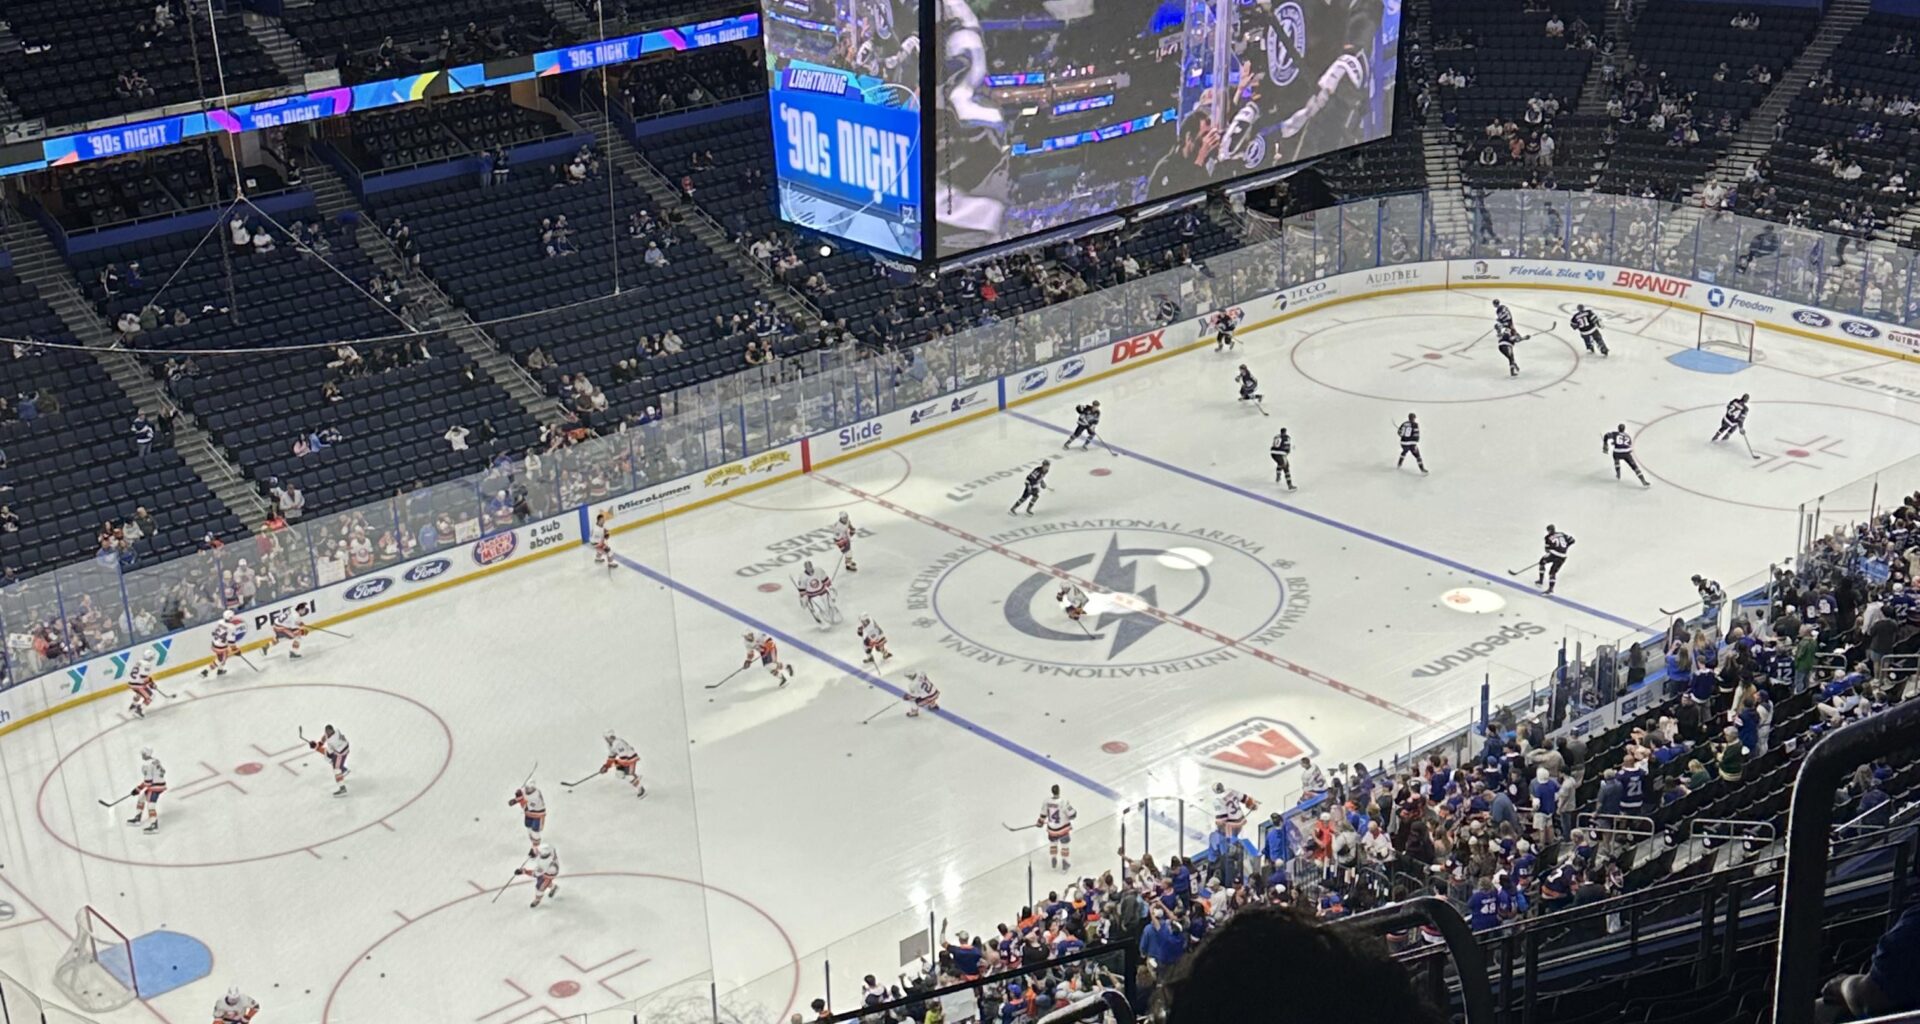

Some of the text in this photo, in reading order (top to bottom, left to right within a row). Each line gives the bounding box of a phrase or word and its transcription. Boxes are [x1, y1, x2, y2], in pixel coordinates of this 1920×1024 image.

[597, 41, 628, 63] NIGHT
[787, 69, 847, 96] LIGHTNING
[87, 125, 166, 155] '90s NIGHT
[780, 102, 910, 199] '90s NIGHT
[1366, 269, 1420, 285] AUDIBEL
[1509, 265, 1553, 277] Florida
[1556, 268, 1582, 279] Blue
[1290, 282, 1327, 299] TECO
[1612, 271, 1692, 299] BRANDT
[1728, 294, 1774, 313] freedom
[1798, 311, 1826, 327] Ford
[1846, 322, 1874, 337] Ford
[1111, 329, 1166, 365] DEX
[1727, 405, 1741, 419] 24
[839, 421, 883, 447] Slide
[1615, 435, 1631, 446] 62
[617, 484, 692, 512] MicroLumen
[531, 520, 561, 538] a sub
[530, 532, 564, 550] above
[412, 562, 443, 581] Ford
[906, 518, 1266, 612] BENCHMARK INTERNATIONAL ARENA
[353, 581, 384, 600] Ford
[937, 576, 1312, 679] BENCHMARK INTERNATIONAL ARENA
[1415, 621, 1547, 677] Spectrum
[1776, 668, 1793, 681] 12
[1196, 722, 1269, 755] Marathon
[1626, 780, 1643, 797] 21
